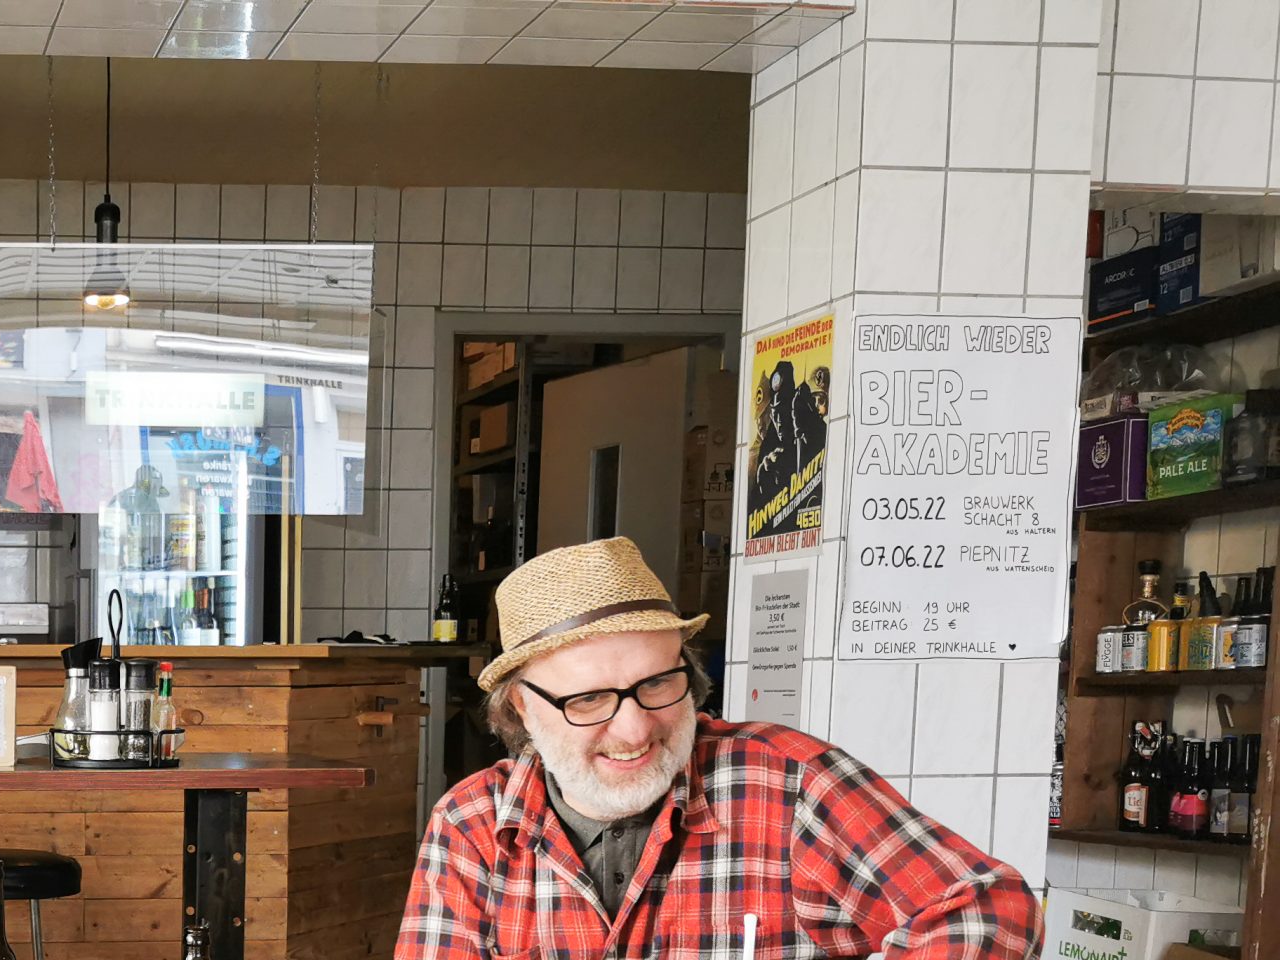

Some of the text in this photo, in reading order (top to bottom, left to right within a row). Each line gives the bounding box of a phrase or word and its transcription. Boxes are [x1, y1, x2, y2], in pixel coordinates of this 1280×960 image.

[1105, 268, 1135, 285] ARCORC
[1160, 282, 1168, 294] 12
[794, 320, 821, 342] FEINDE
[859, 325, 1052, 354] ENDLICH WIEDER
[781, 333, 832, 358] DEMOKRATIE!
[277, 375, 343, 390] TRINKHALLE
[96, 390, 255, 410] TRNKHALLE
[860, 370, 988, 426] BIER-
[857, 431, 1050, 475] AKADEMIE
[1160, 460, 1208, 478] PALE ALE
[748, 486, 789, 539] HINWEG
[790, 448, 825, 500] DAMIT!
[862, 496, 1034, 520] 03.05.22 BRAUWERK
[796, 508, 822, 528] 4630
[964, 512, 1040, 526] SCHACHT 8
[745, 528, 822, 557] BOCHUM BLEIBT BUNT
[860, 545, 1030, 568] 07.06.22 PIEPNITZ
[1004, 565, 1055, 574] WATTENSCHEID
[852, 601, 970, 614] BEGINN 19 UHR
[768, 612, 785, 622] 3,50 €
[852, 618, 958, 632] BEITRAG 25 €
[786, 644, 794, 652] 1,50
[852, 642, 997, 654] IN DEINER TRINKHALLE
[773, 663, 784, 672] gegen
[784, 662, 797, 671] Spende
